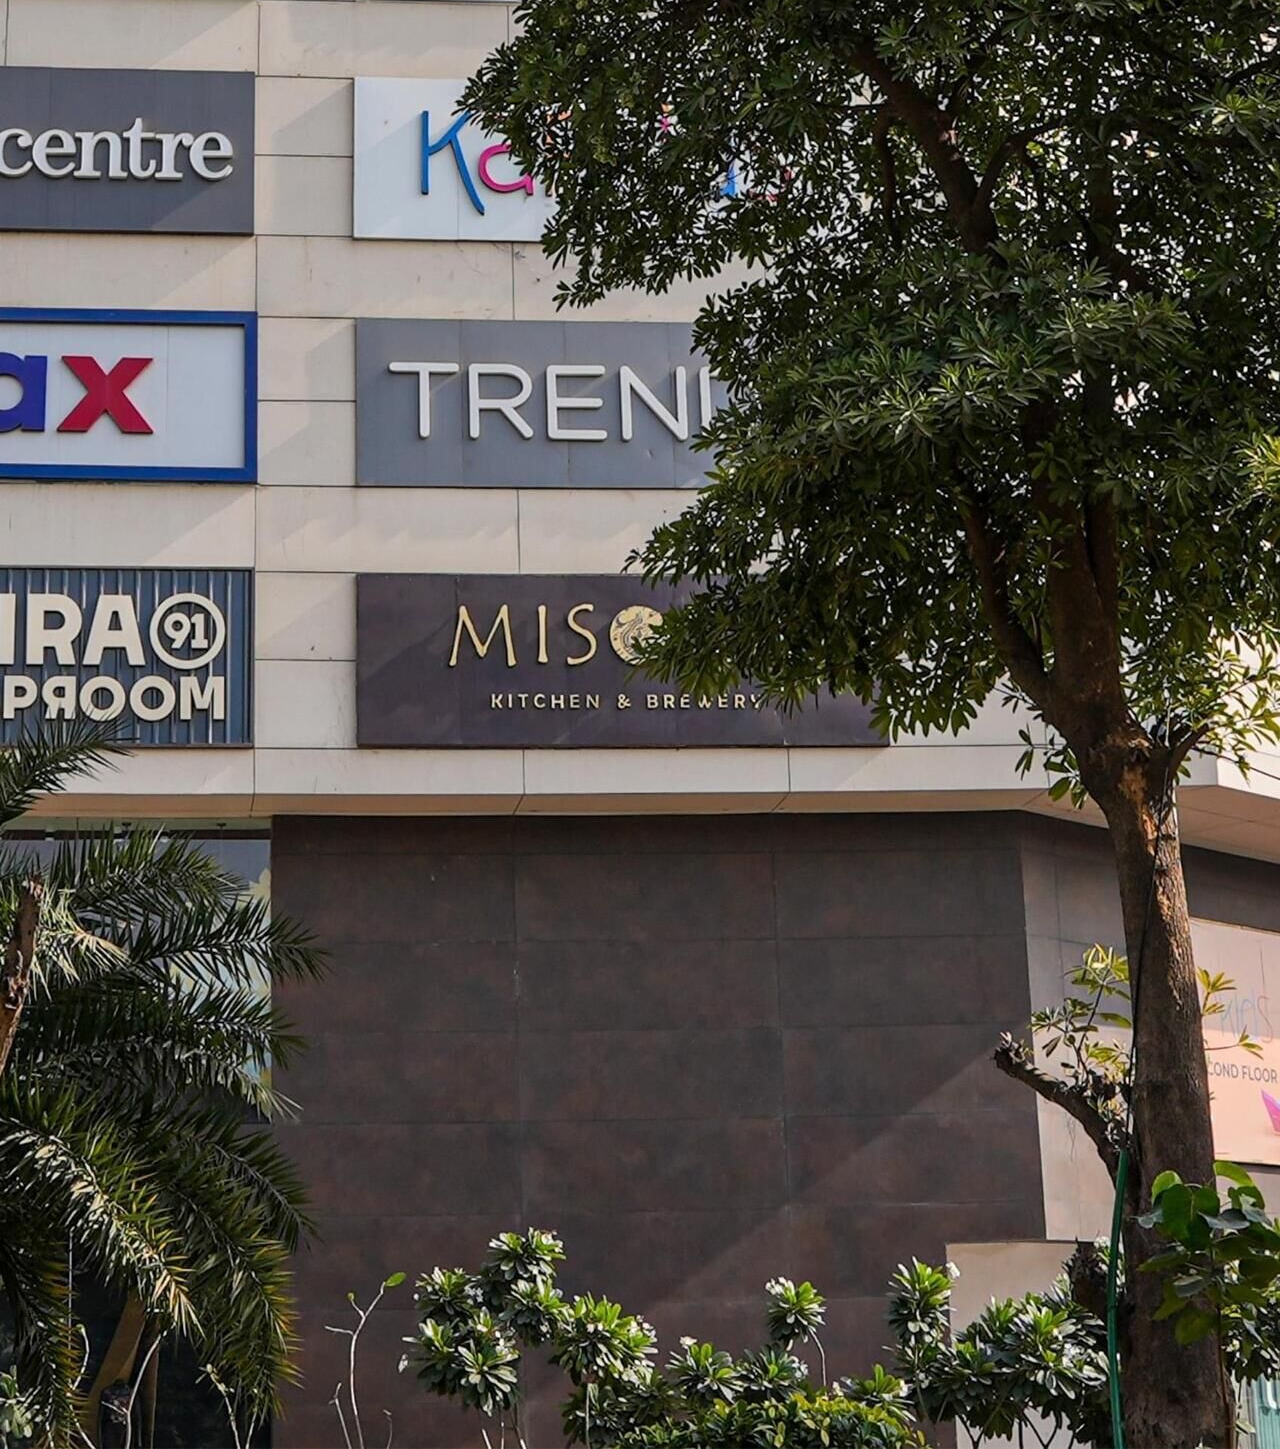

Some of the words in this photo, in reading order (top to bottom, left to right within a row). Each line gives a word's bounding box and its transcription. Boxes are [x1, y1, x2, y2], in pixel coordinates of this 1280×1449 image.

[163, 611, 210, 650] 91
[489, 692, 602, 711] KITCHEN
[616, 693, 632, 710] &
[645, 693, 763, 711] BREWERY
[1241, 1064, 1278, 1084] FLOOR
